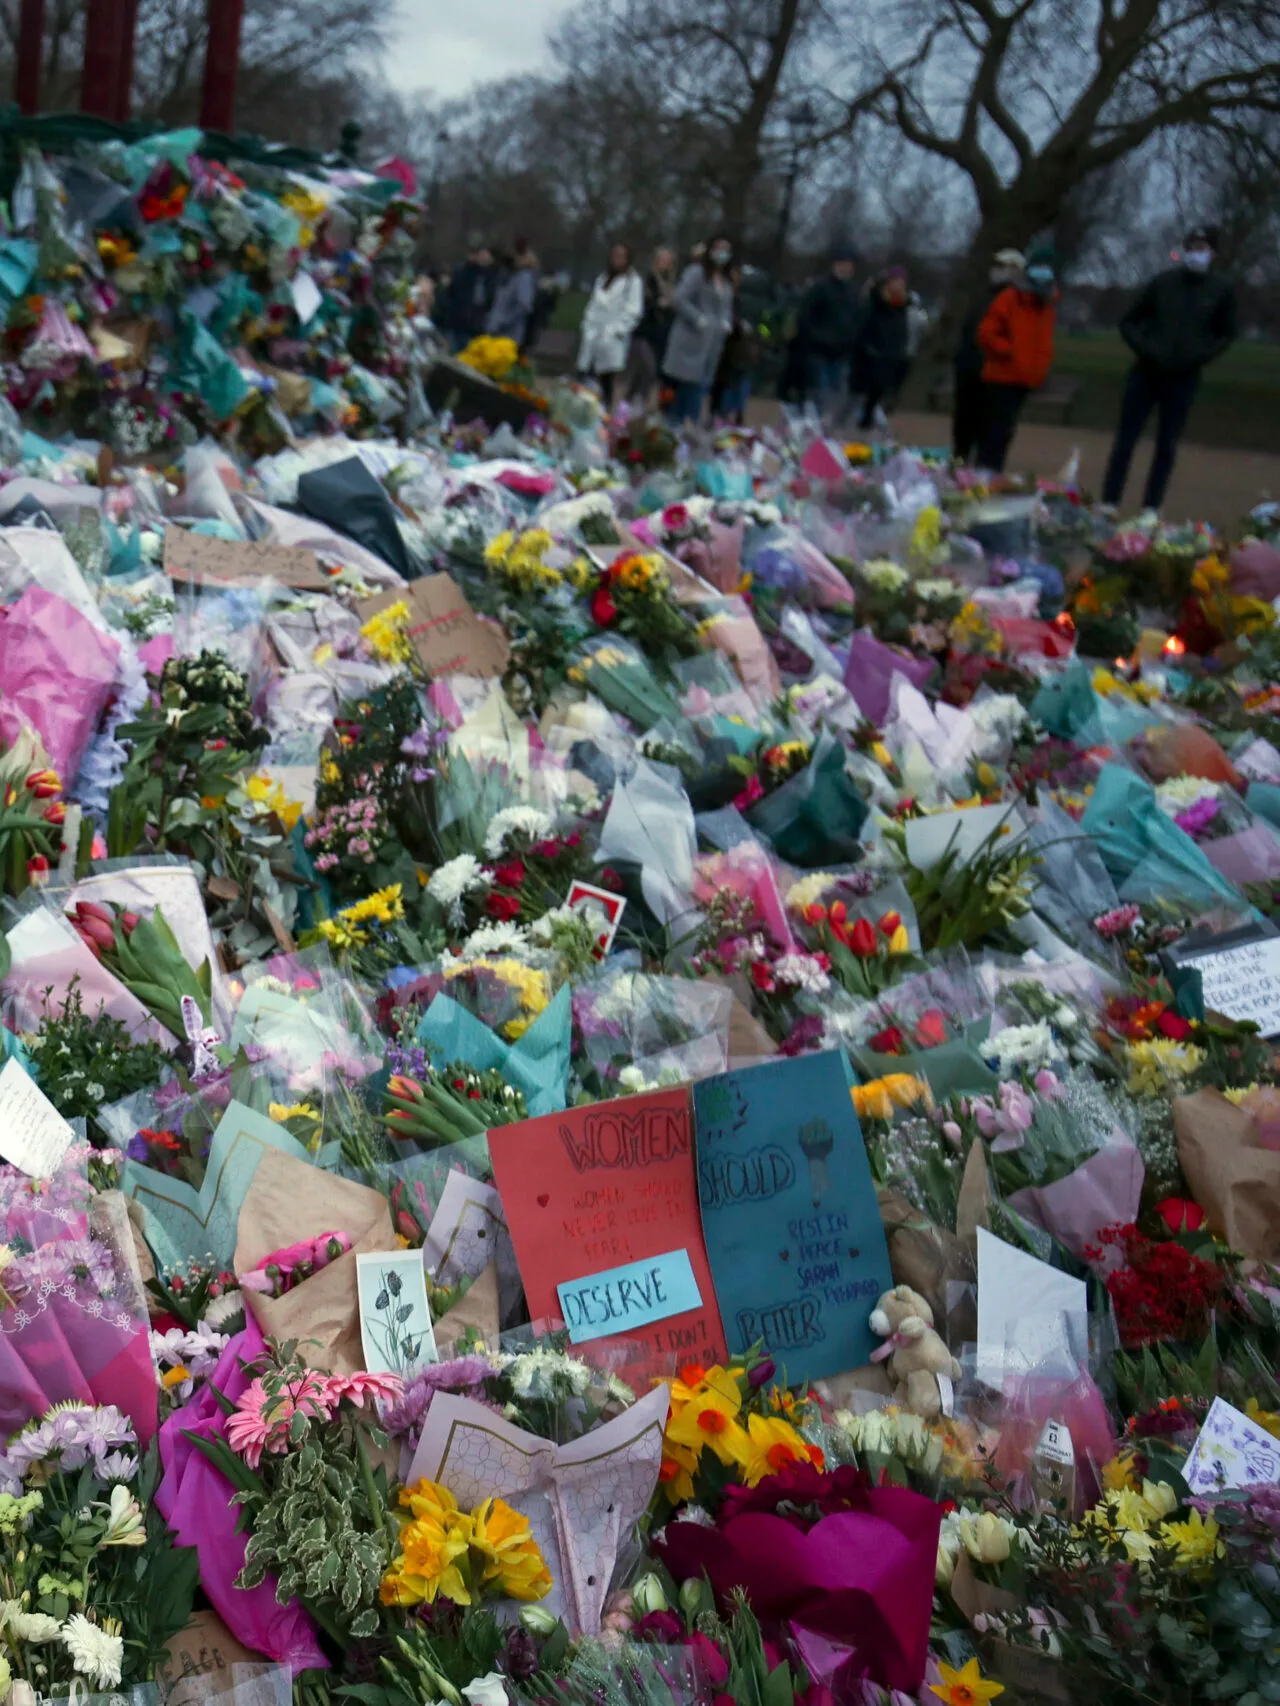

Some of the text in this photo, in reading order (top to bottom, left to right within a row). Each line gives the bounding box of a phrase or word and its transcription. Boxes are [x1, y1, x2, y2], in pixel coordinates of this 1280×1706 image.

[559, 1107, 689, 1174] WOMEN
[700, 1144, 797, 1209] SHOULD
[562, 1208, 617, 1238] NEVER
[788, 1212, 849, 1241] REST IN
[563, 1266, 667, 1327] DESERVE
[737, 1294, 826, 1352] BETTER
[669, 1320, 707, 1350] DON'T
